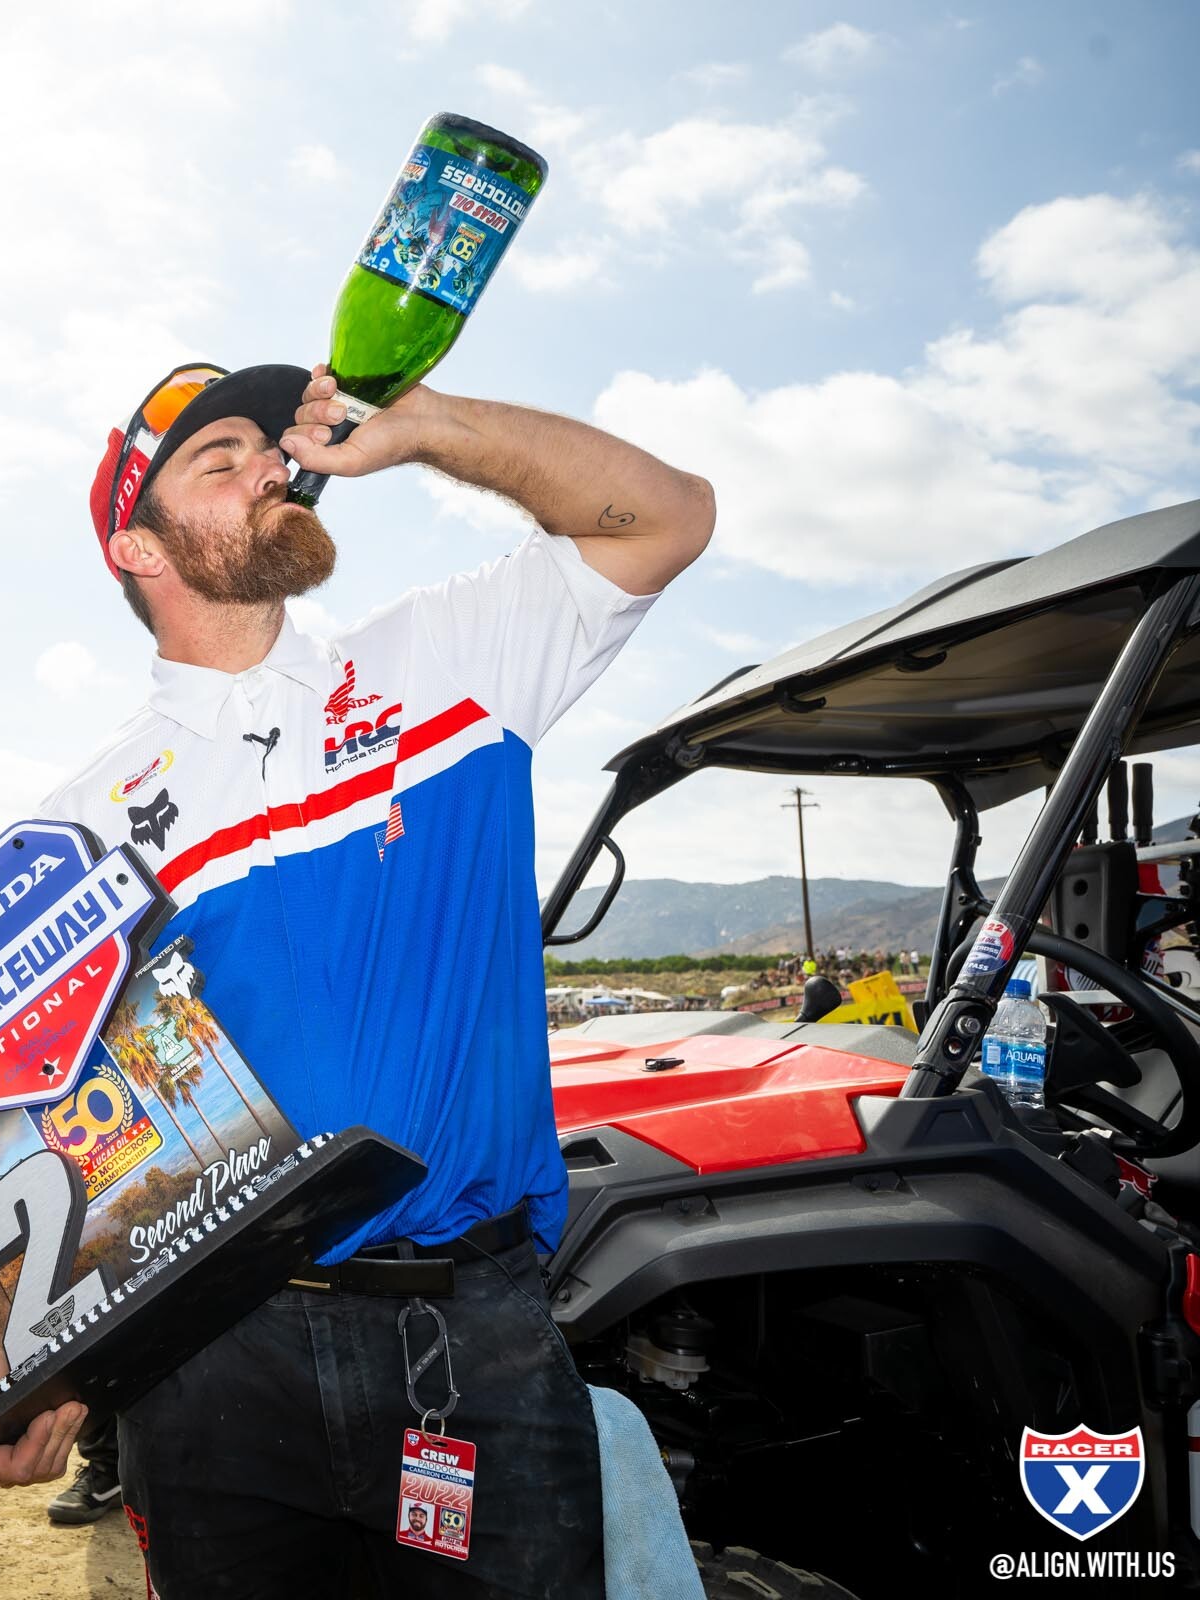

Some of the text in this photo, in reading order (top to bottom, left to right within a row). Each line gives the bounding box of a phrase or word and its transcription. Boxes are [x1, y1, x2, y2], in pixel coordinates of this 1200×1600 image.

[452, 194, 508, 231] LUCAS OIL
[452, 237, 476, 260] 50
[118, 463, 142, 511] FOX
[324, 702, 403, 766] HRC
[325, 737, 400, 774] Honda RACIN
[134, 934, 186, 979] PRESENTED BY
[969, 961, 990, 972] PASS
[19, 1027, 54, 1056] PALA
[49, 1077, 125, 1156] 50
[85, 1129, 154, 1189] RO MOTOCROSS
[91, 1135, 129, 1169] LUCAS OIL
[93, 1146, 148, 1192] CHAMPIONSHIP
[129, 1136, 272, 1263] Second Place
[408, 1466, 441, 1479] CAMERON
[417, 1459, 461, 1476] PADDOCK
[420, 1448, 460, 1467] CREW
[402, 1474, 472, 1511] 2022
[444, 1508, 463, 1527] 50
